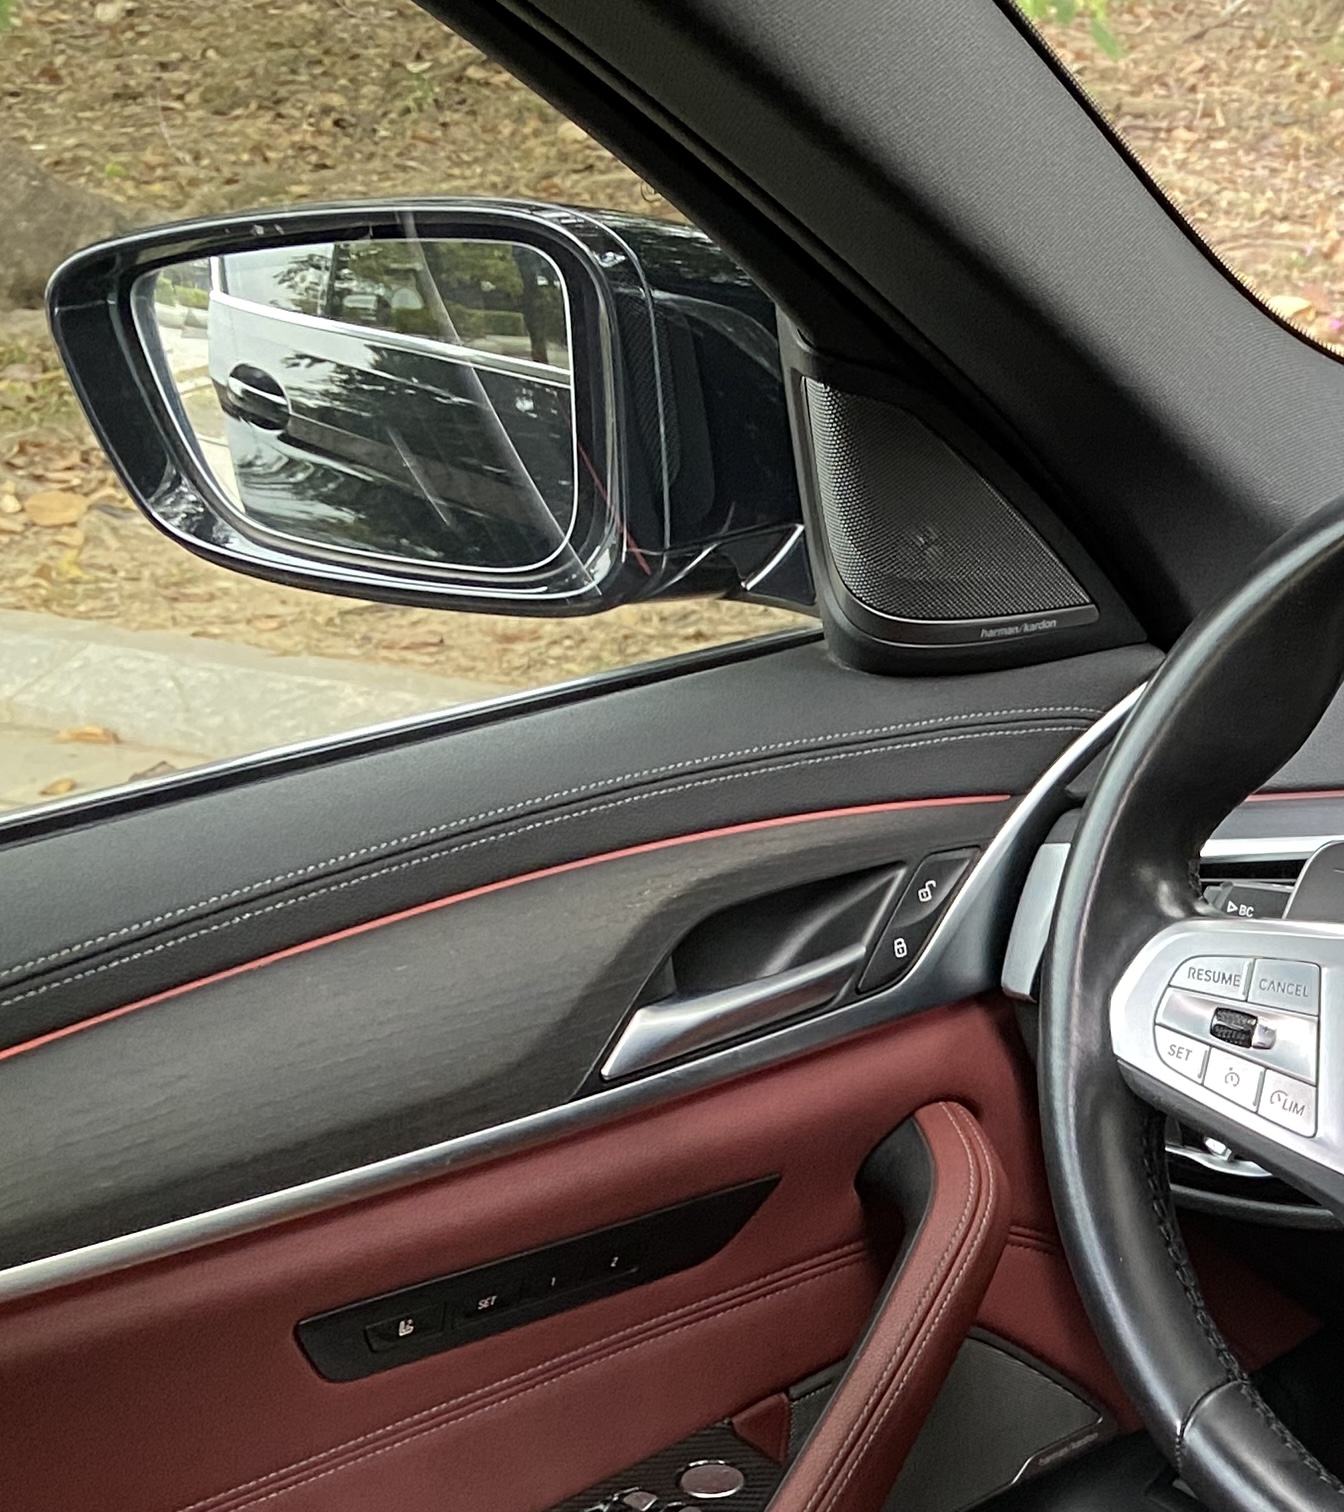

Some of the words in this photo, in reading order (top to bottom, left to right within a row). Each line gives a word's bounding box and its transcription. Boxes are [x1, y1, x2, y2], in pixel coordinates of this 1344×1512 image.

[980, 619, 1057, 638] harman/kardon
[1239, 904, 1254, 917] BC
[1188, 966, 1241, 988] RESUME
[1258, 977, 1309, 998] CANCEL
[1167, 1043, 1193, 1063] SET
[1282, 1101, 1306, 1117] LIM
[610, 1256, 619, 1268] 2
[477, 1295, 498, 1310] SET
